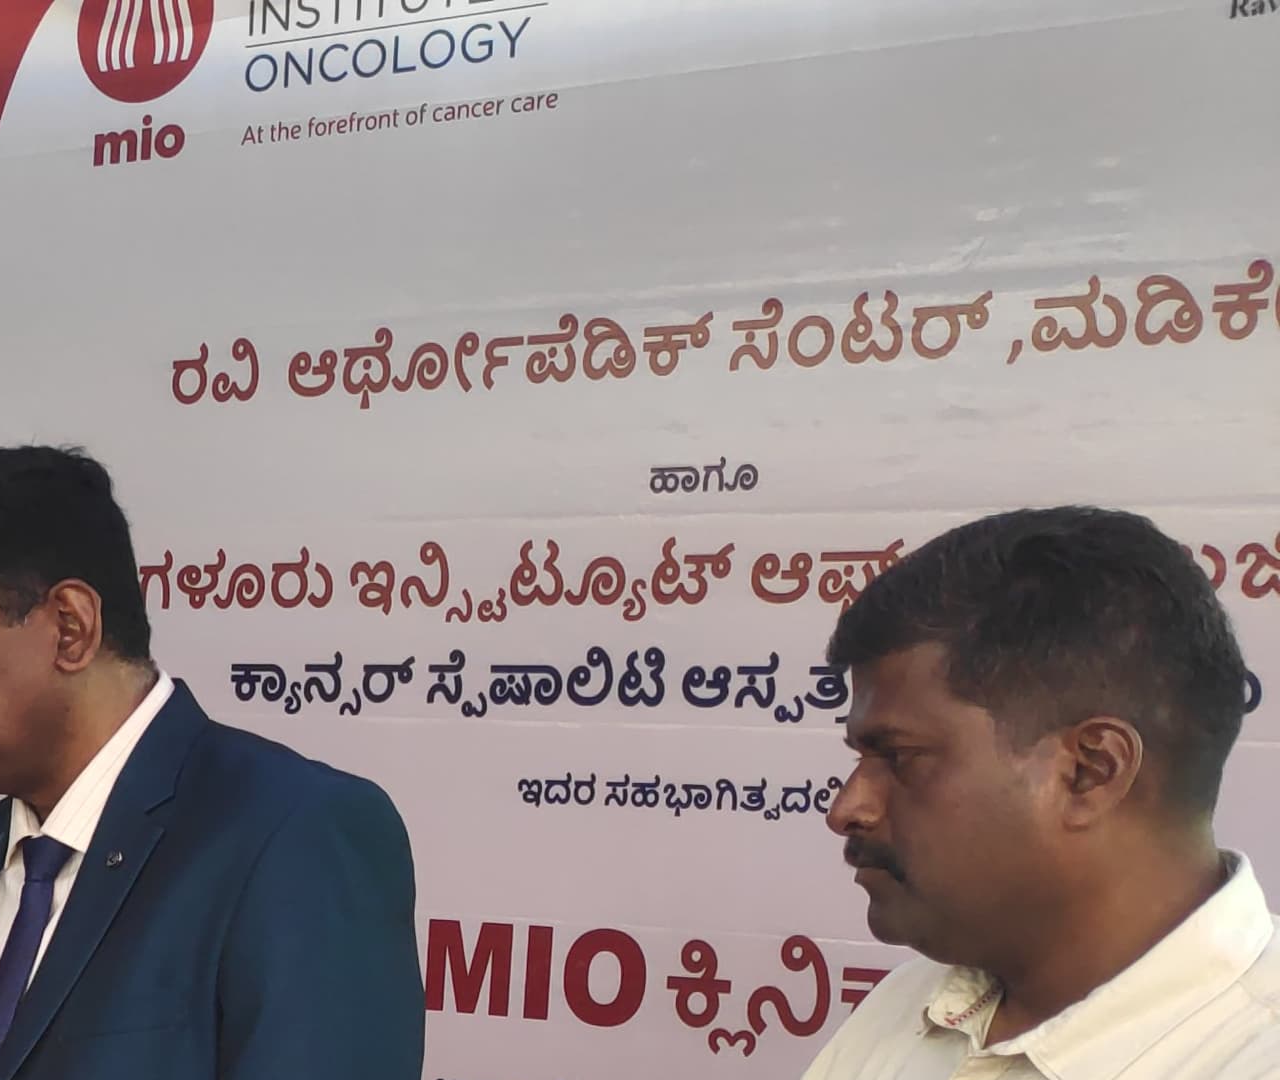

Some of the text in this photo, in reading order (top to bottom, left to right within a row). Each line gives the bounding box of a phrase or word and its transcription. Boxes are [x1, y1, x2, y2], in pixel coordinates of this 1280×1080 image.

[244, 17, 531, 92] ONCOLOGY
[93, 114, 186, 167] mio
[241, 92, 559, 146] At the forefront of cancer care
[172, 336, 260, 406] ರವಿ
[729, 290, 994, 372] ಸೆಂಟರ್
[649, 456, 759, 493] ಹಾಗೂ
[139, 547, 334, 610] ಗಳೂರು
[517, 773, 597, 808] ಇದರ
[424, 918, 647, 1028] MIO
